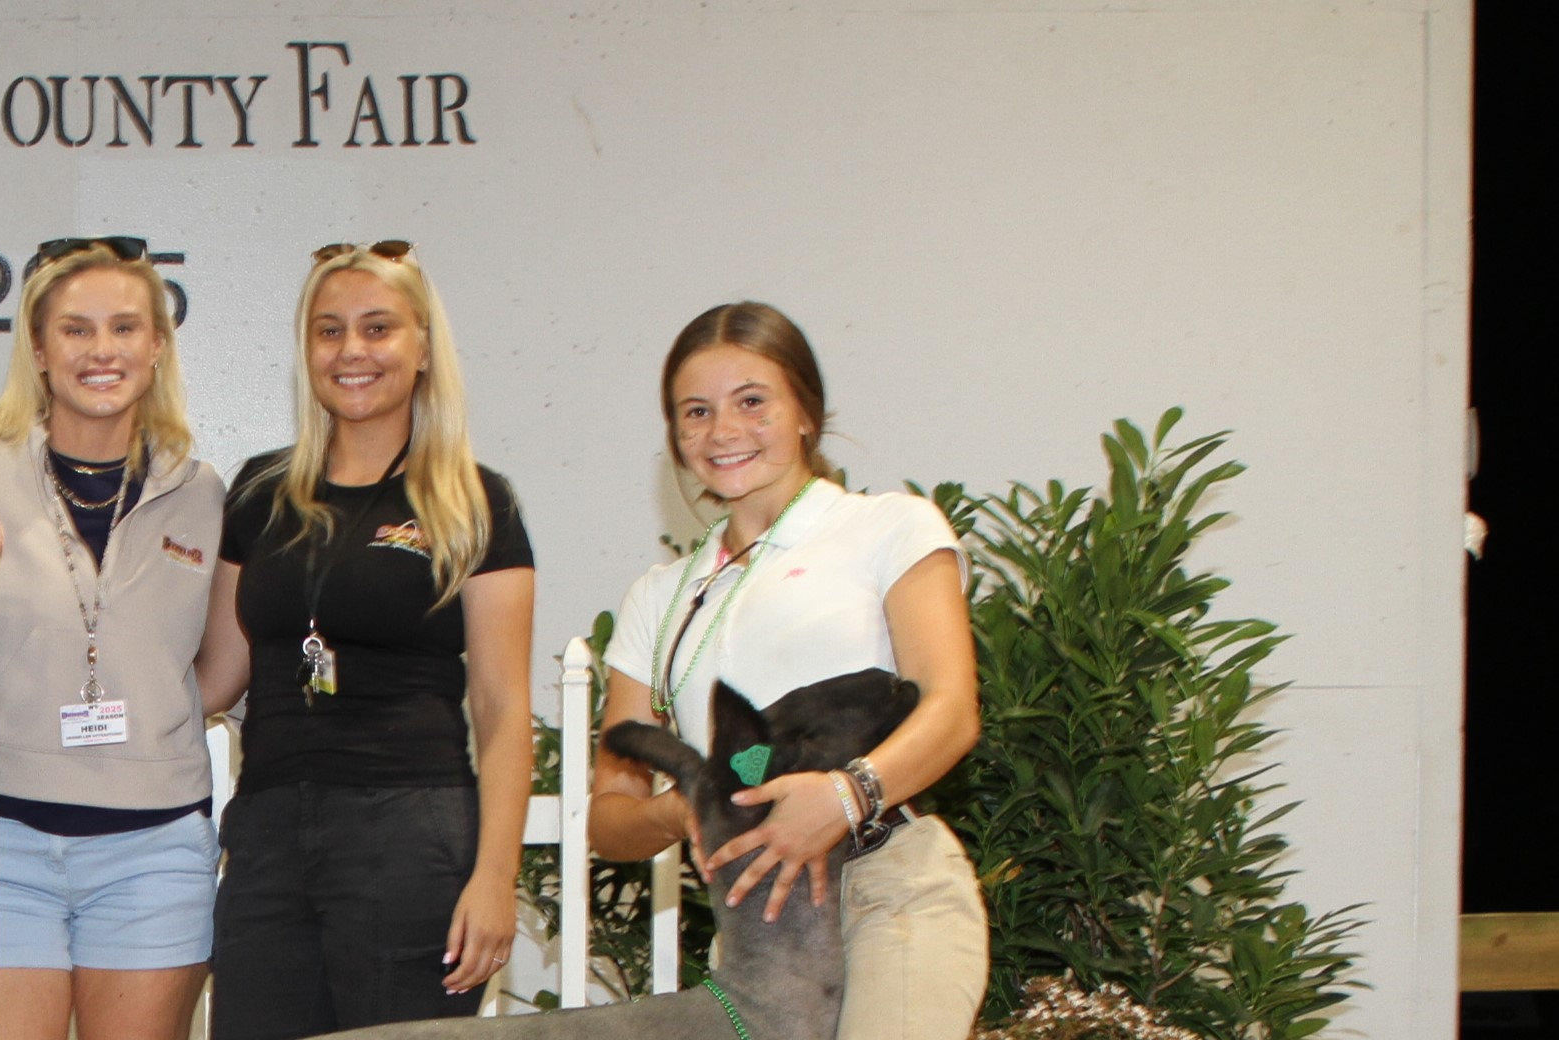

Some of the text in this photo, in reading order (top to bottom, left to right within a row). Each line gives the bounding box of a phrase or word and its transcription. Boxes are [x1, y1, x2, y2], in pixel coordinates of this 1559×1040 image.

[285, 41, 478, 149] FAIR
[99, 704, 122, 714] 2025
[80, 723, 108, 733] HEIDI
